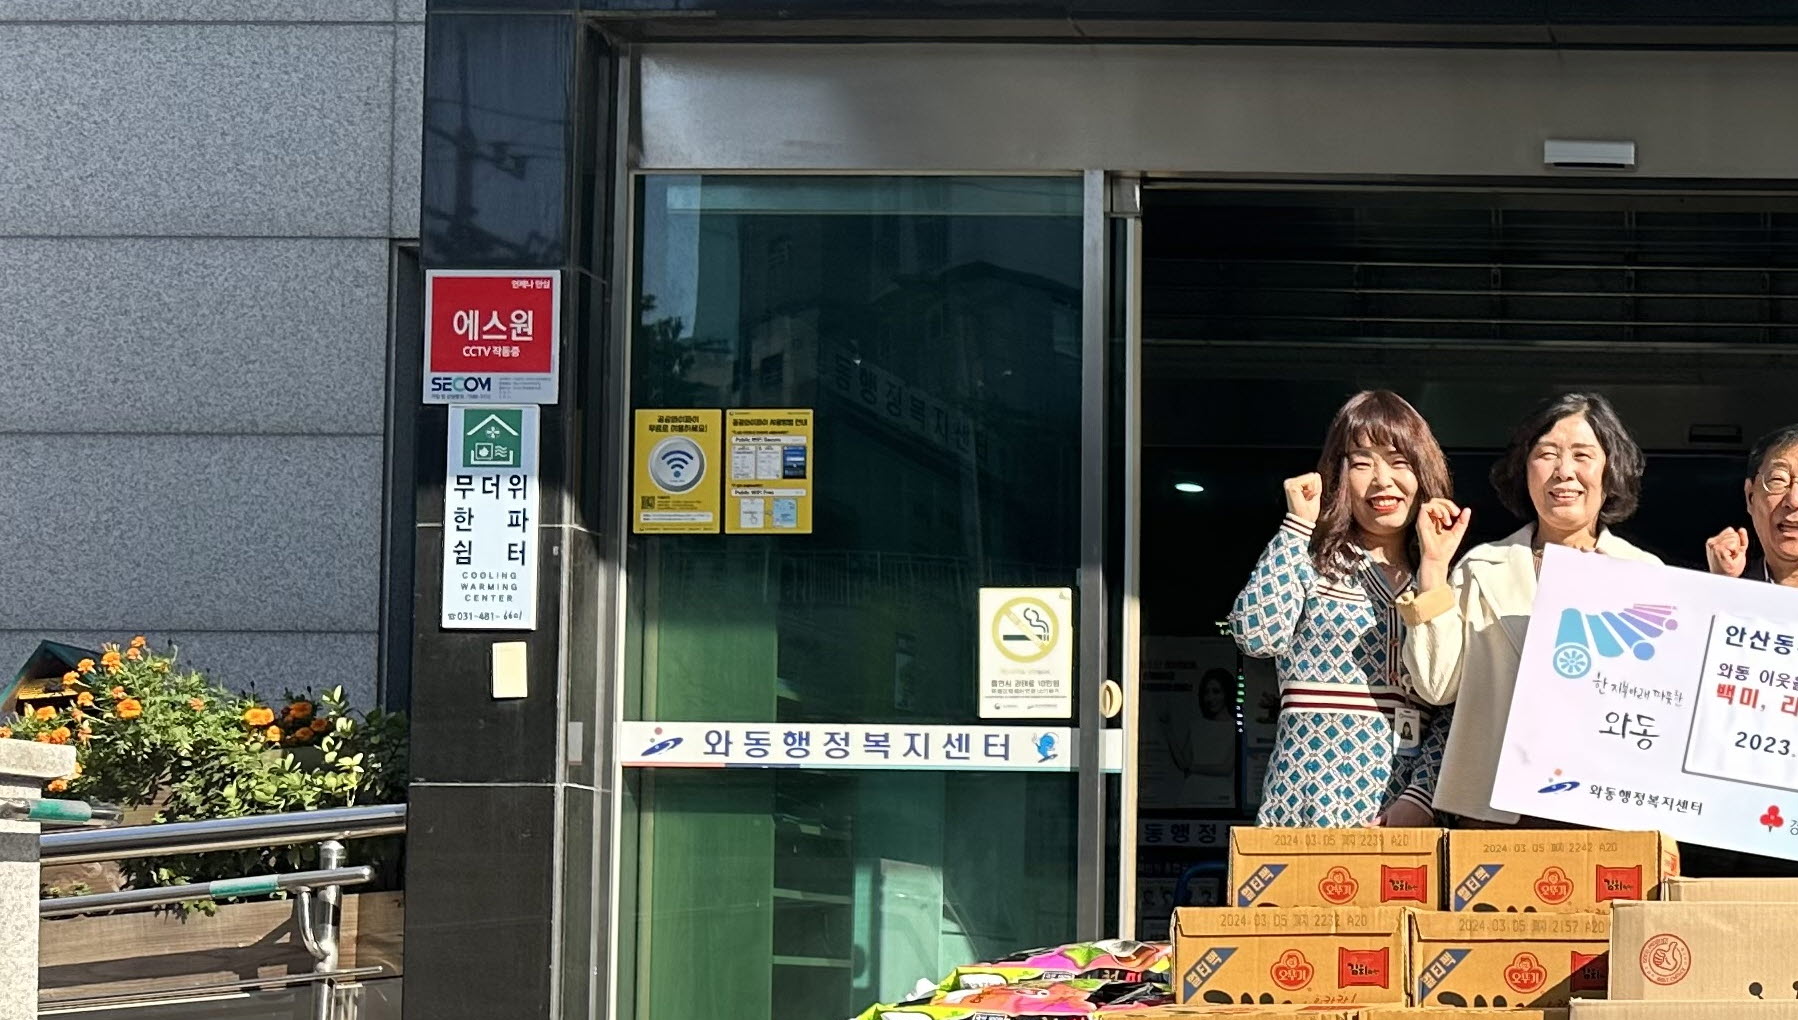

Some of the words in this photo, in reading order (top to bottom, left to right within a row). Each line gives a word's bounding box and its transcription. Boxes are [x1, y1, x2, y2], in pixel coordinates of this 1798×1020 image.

[453, 309, 534, 341] 에스원
[463, 346, 491, 357] CCTV
[492, 346, 520, 357] 작동중
[431, 377, 492, 392] SECOM
[453, 474, 528, 500] 무더위
[460, 583, 518, 591] WARMING
[462, 571, 517, 580] COOLING
[464, 594, 513, 602] CENTER
[1716, 662, 1750, 682] 와동
[1716, 682, 1766, 712] 백미,
[1598, 711, 1660, 750] 와동
[702, 729, 1011, 761] 와동행정복지센터
[1589, 784, 1703, 816] 와동행정복지센터
